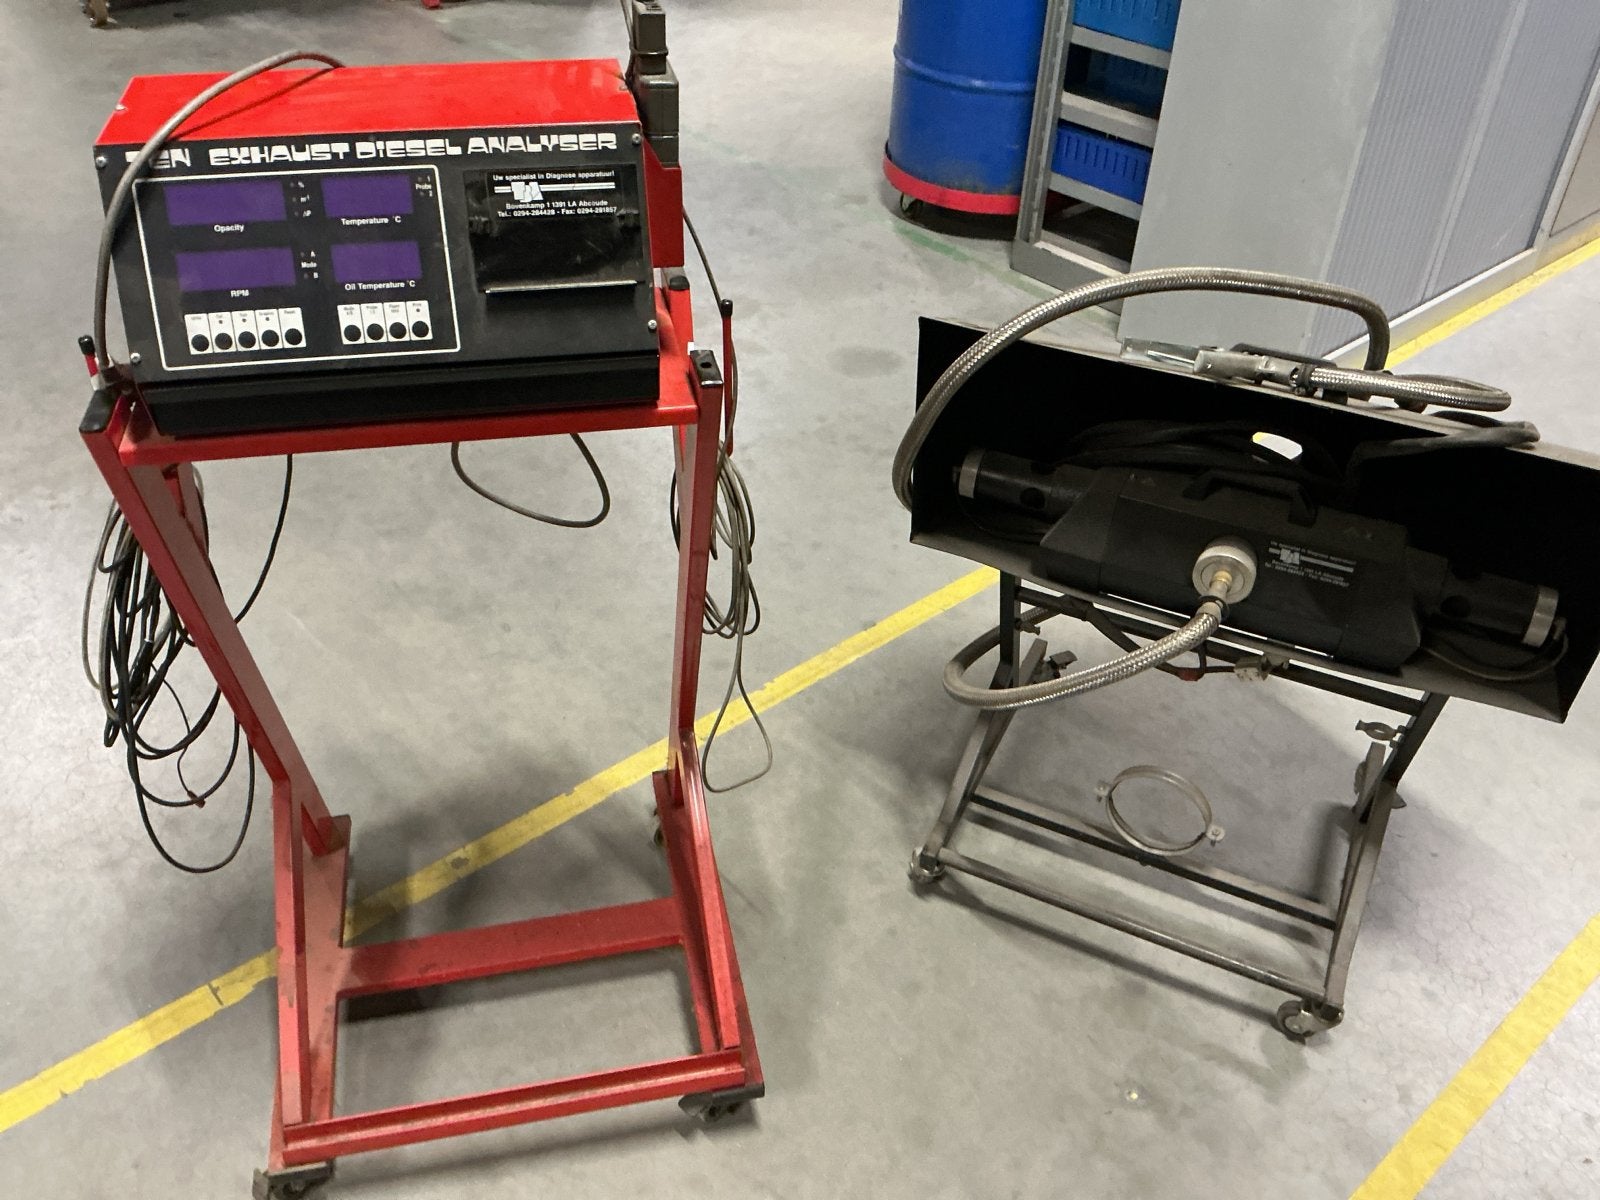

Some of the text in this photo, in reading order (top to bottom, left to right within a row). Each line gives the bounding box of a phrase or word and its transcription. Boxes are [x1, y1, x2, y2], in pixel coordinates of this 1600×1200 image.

[209, 142, 350, 166] EXHAUST
[467, 132, 617, 155] ANALYSER
[505, 173, 536, 181] specialist
[546, 171, 576, 180] Diagnose
[505, 202, 545, 210] Bovenkamp
[341, 217, 389, 226] Temperature
[214, 224, 245, 233] Opacity
[344, 283, 356, 291] Oil
[357, 281, 405, 291] Temperature
[230, 289, 250, 298] RPM
